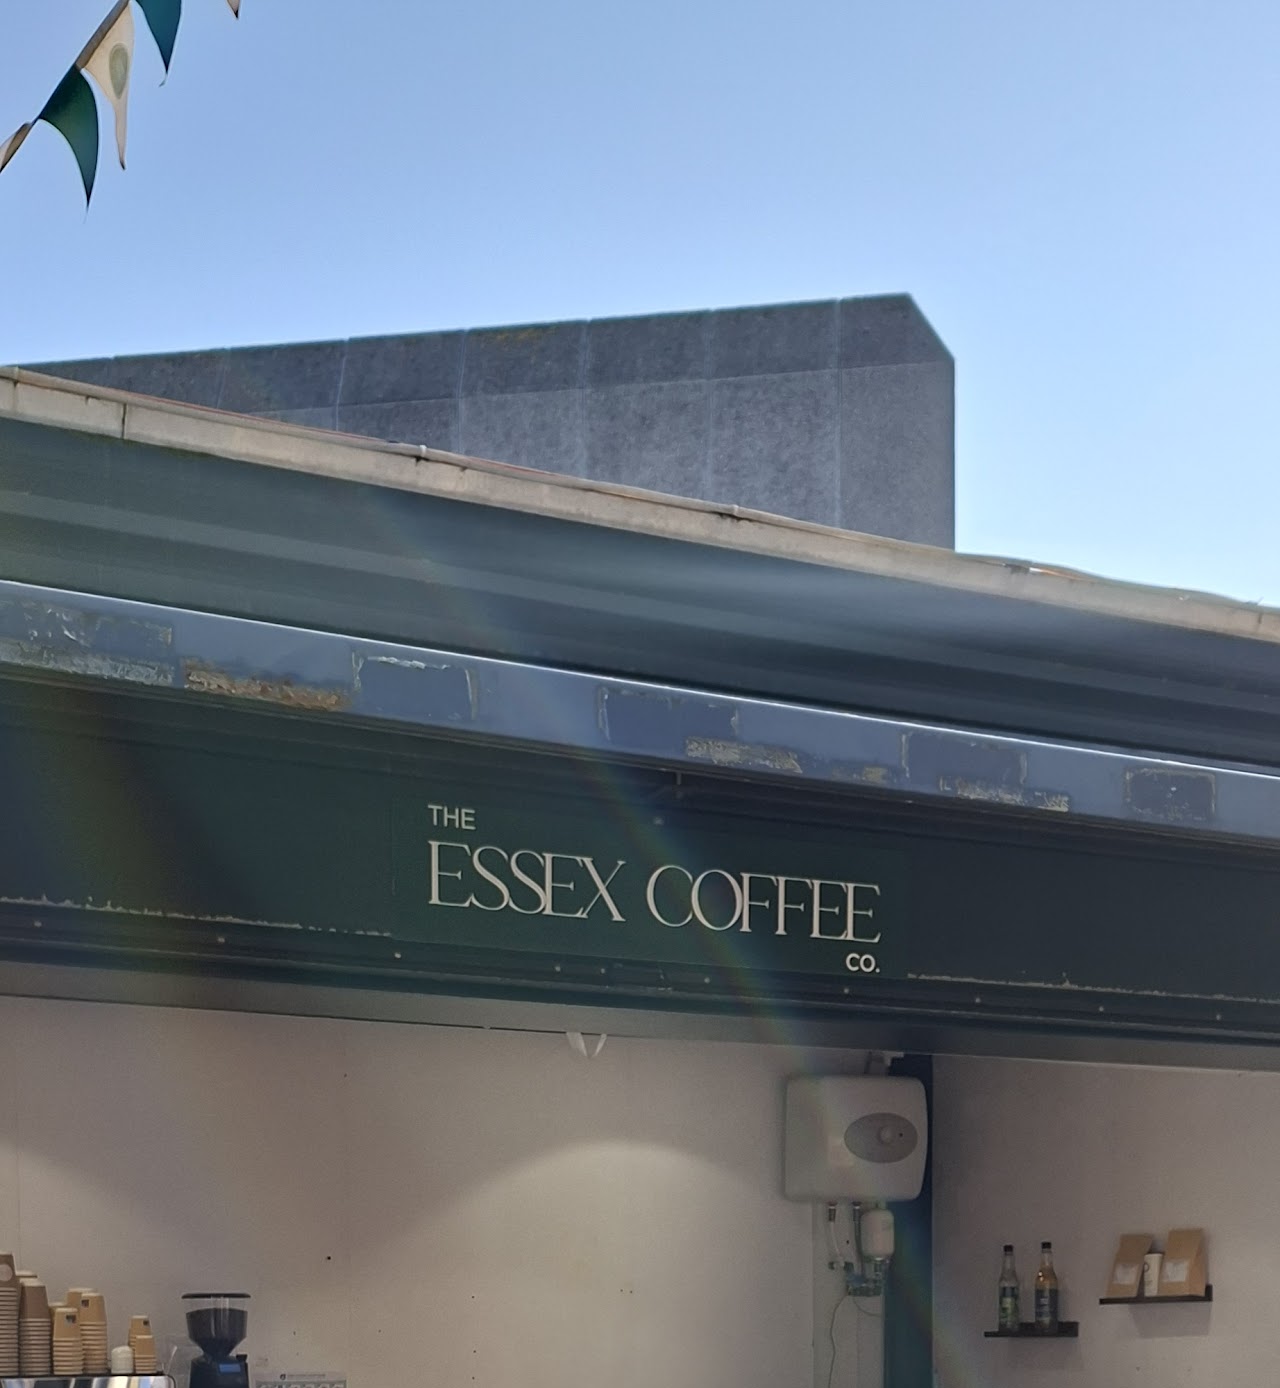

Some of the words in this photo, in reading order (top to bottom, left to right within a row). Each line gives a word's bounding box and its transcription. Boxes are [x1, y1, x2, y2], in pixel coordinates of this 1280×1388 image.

[427, 804, 476, 830] THE
[428, 840, 626, 922] ESSEX
[646, 865, 880, 943] COFFEE
[845, 953, 880, 973] CO.
